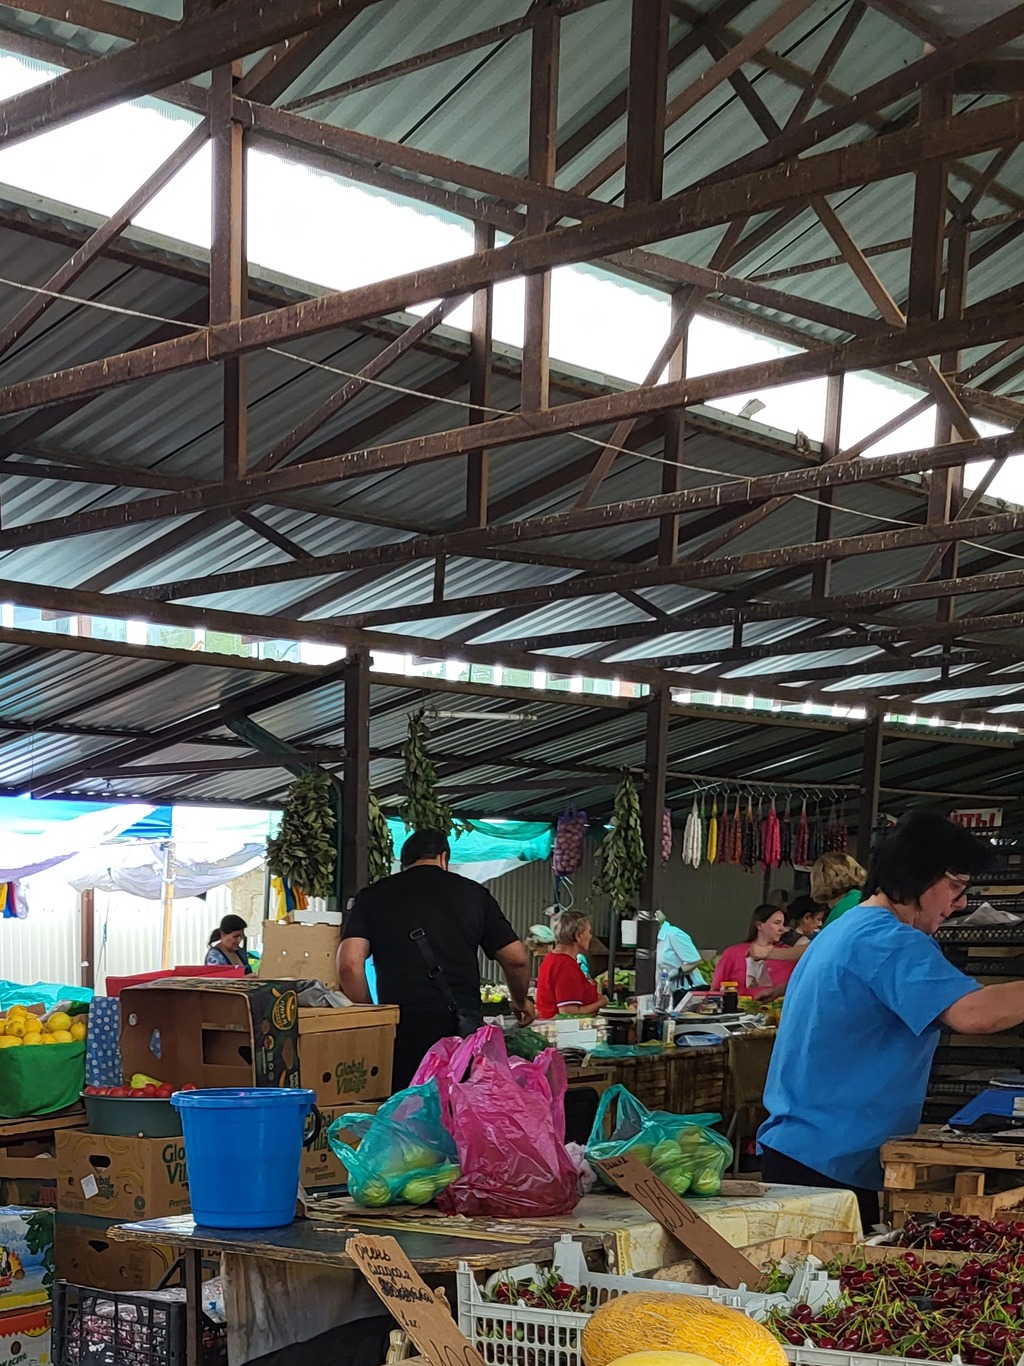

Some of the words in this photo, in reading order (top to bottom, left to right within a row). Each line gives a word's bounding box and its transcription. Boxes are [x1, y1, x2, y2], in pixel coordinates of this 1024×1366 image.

[335, 1057, 366, 1079] Global
[336, 1074, 367, 1095] Village
[162, 1143, 186, 1164] Glo
[166, 1162, 189, 1184] Vil
